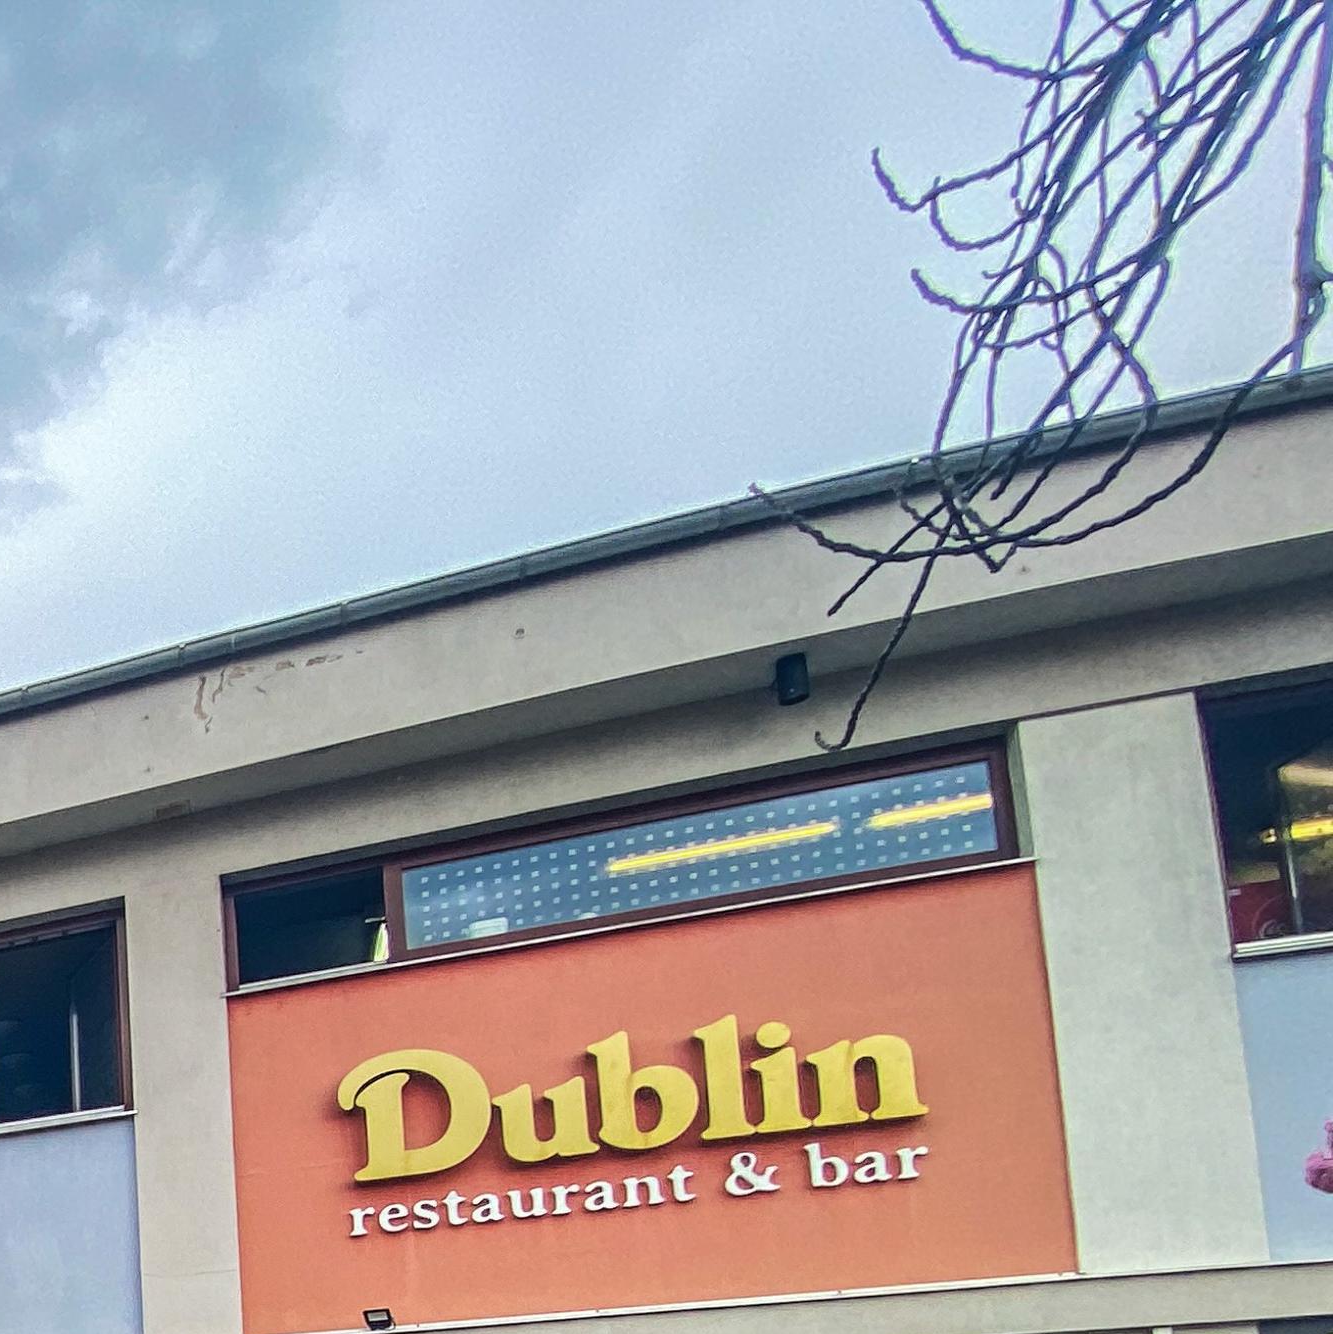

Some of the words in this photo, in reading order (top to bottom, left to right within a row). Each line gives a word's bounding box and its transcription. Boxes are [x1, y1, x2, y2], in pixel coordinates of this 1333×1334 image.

[337, 1014, 929, 1181] Dublin
[349, 1164, 697, 1237] restaurant
[724, 1151, 782, 1198] &
[803, 1142, 931, 1189] bar
